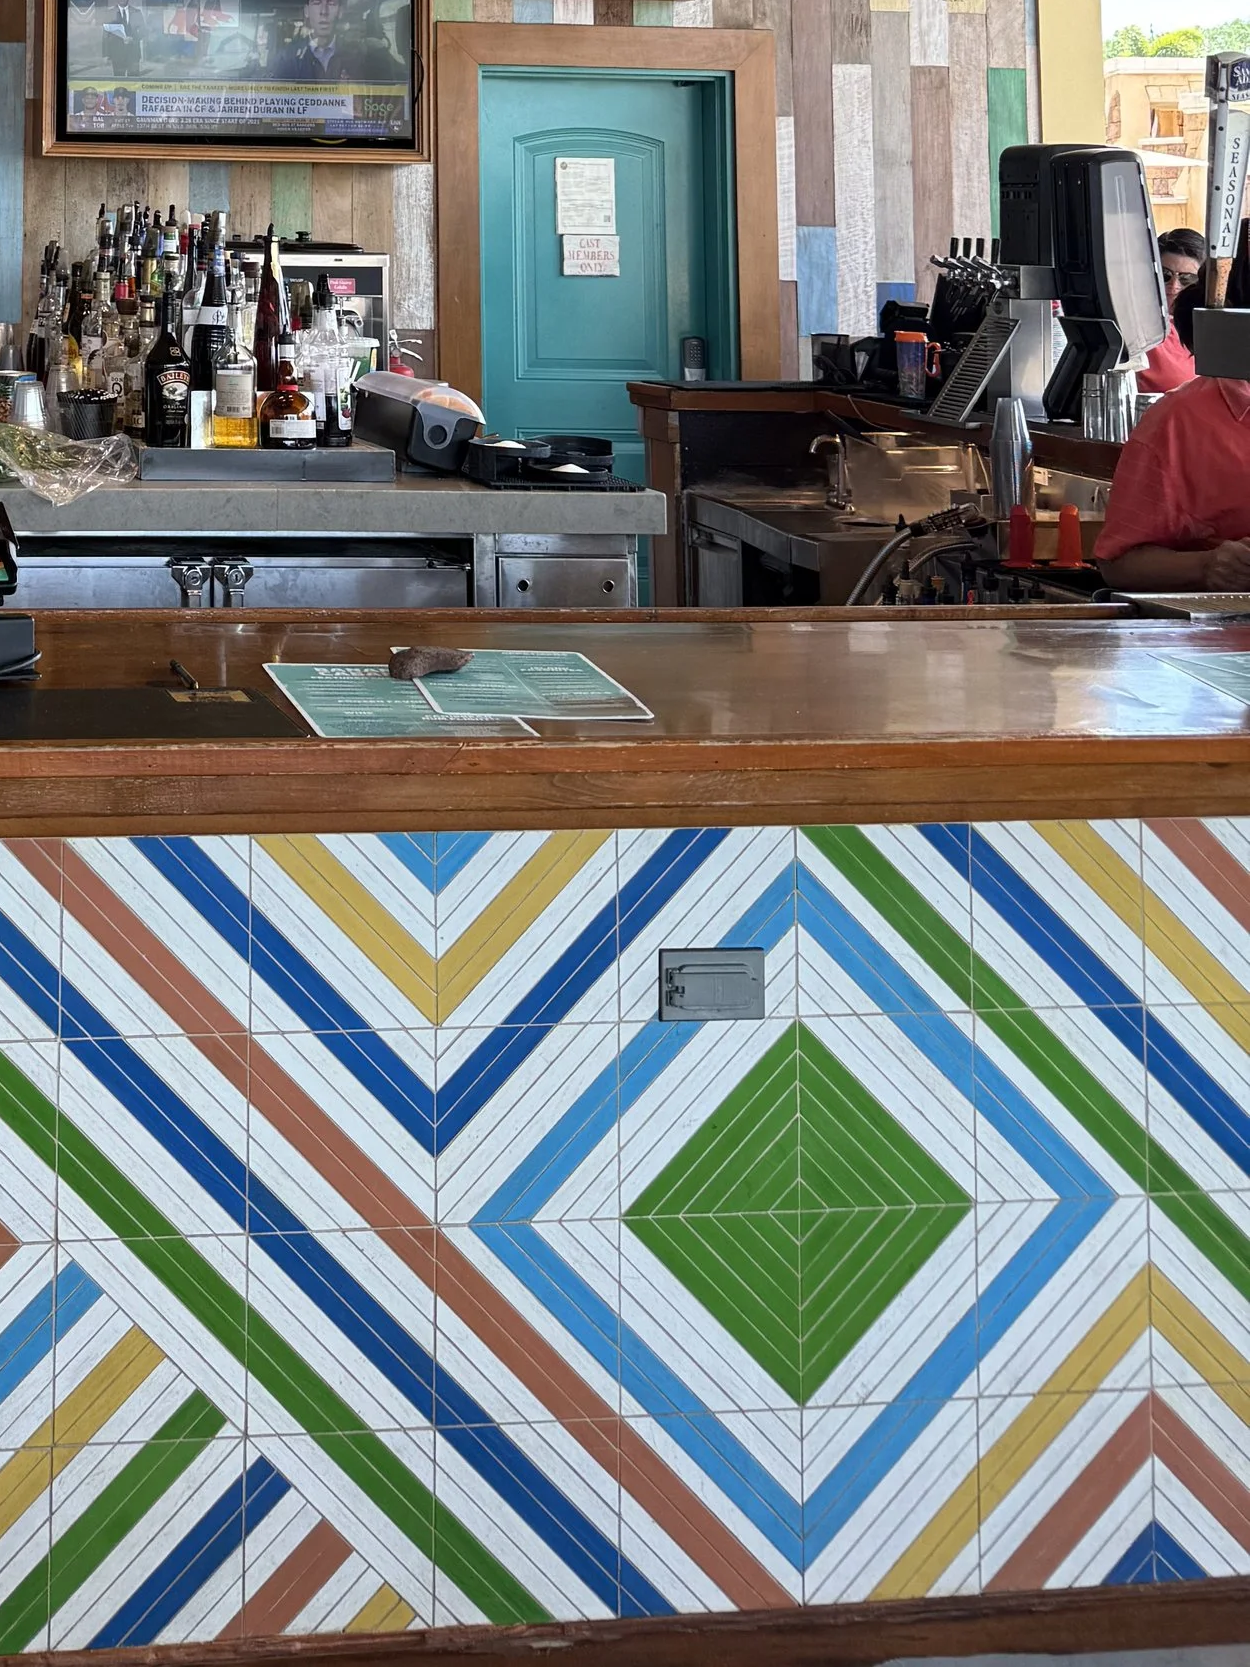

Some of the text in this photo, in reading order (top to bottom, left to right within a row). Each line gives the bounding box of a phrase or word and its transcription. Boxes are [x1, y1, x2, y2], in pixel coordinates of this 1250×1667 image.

[141, 95, 347, 107] DECISION-MAKING BEHIND PLAYING CEDDANNE
[141, 104, 308, 115] RAFAELA IN CF & JARREN DURAN IN LF
[1220, 137, 1241, 248] SEASONAL
[579, 238, 600, 249] CAST
[568, 250, 615, 260] MEMBERS
[580, 263, 604, 273] ONLY
